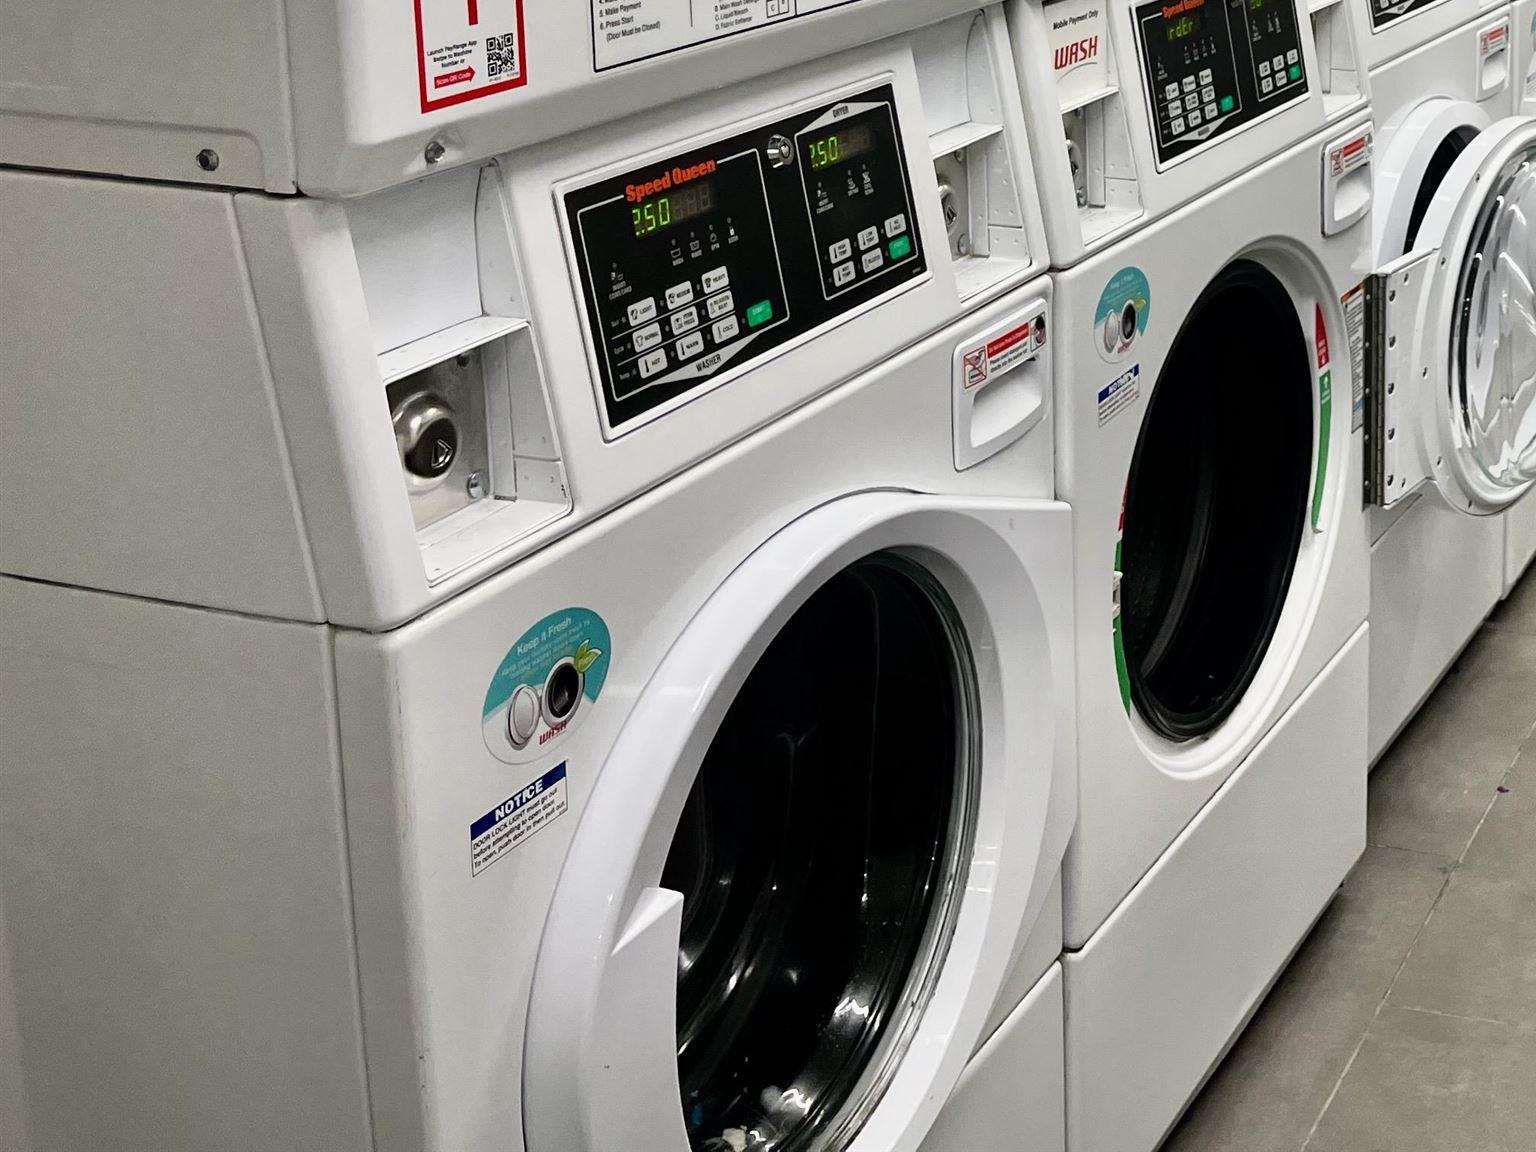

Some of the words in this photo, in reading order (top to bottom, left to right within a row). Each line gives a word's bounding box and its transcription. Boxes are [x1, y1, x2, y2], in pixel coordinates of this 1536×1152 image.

[1162, 0, 1184, 19] Speed
[1055, 36, 1098, 70] WASH
[833, 106, 849, 118] DRYER
[626, 171, 671, 202] Speed
[672, 159, 716, 184] Queen
[696, 354, 722, 372] WASHER
[517, 638, 540, 657] Keep
[548, 617, 572, 637] Fresh
[495, 779, 543, 822] NOTICE
[473, 833, 491, 850] DOOR
[492, 822, 508, 838] LOCK
[509, 809, 526, 826] LIGHT
[473, 844, 491, 859] before
